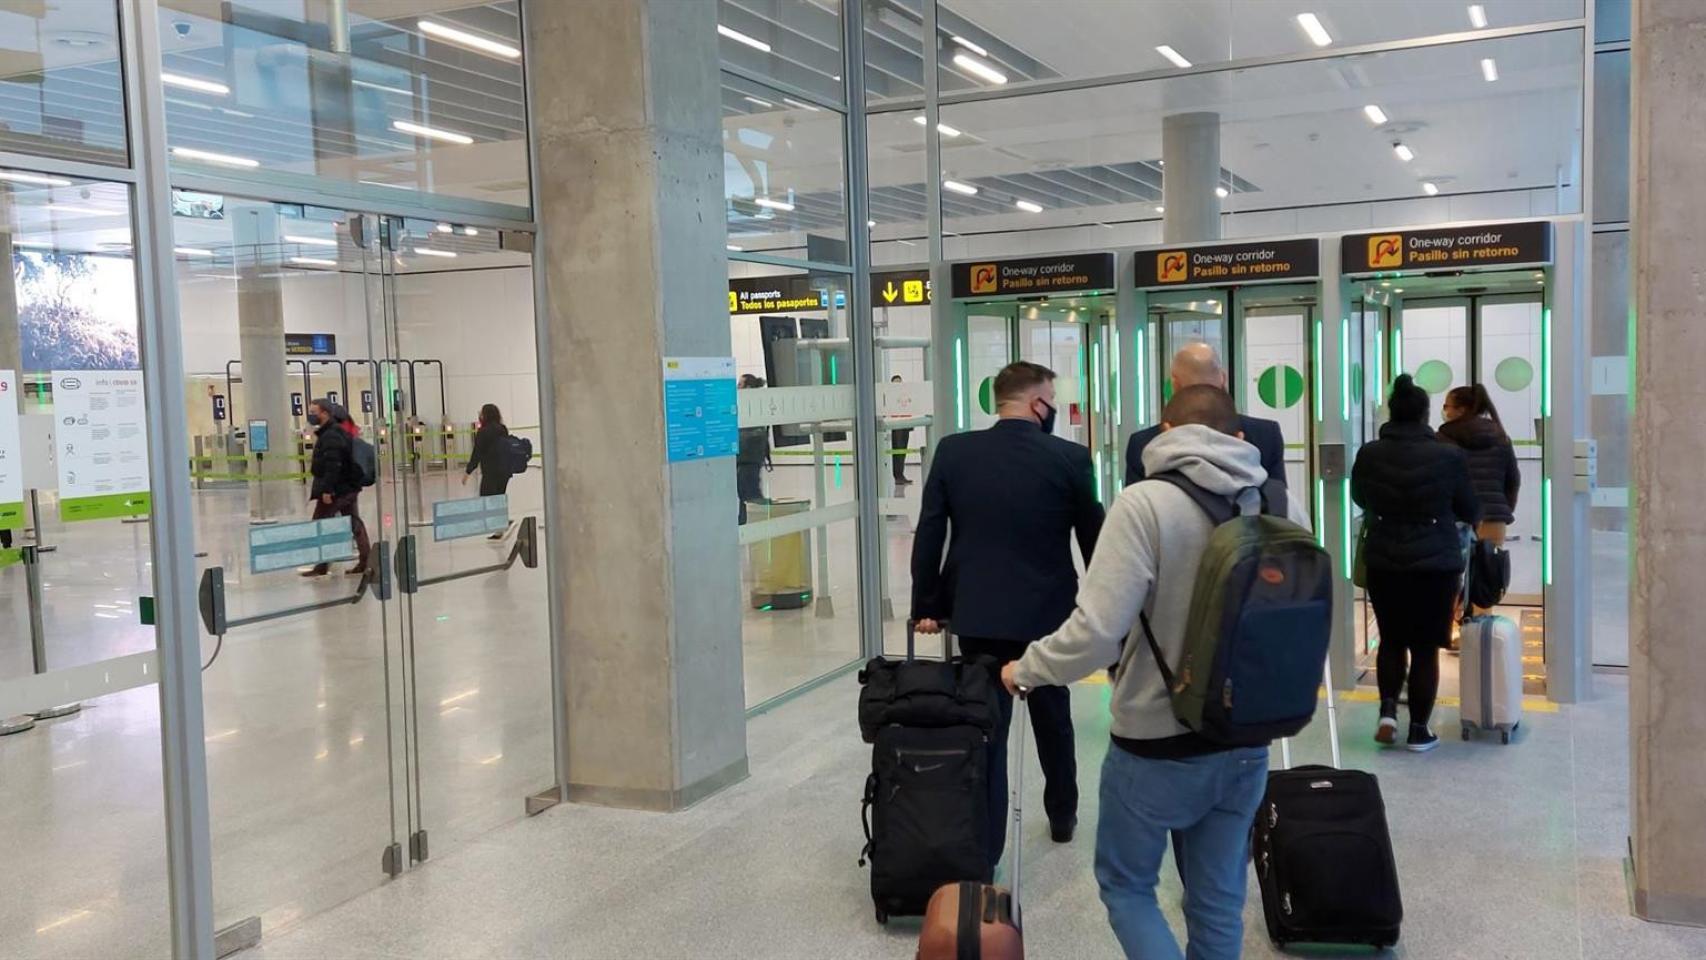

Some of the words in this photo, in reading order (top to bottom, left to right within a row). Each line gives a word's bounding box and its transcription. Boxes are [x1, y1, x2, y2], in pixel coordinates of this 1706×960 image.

[1409, 236, 1454, 249] One-way
[1457, 233, 1502, 245] corridor
[1193, 252, 1233, 265] One-way
[1236, 250, 1275, 261] corridor
[1409, 250, 1449, 262] Pasillo
[1452, 248, 1469, 259] sin
[1473, 246, 1519, 257] retorno
[1002, 266, 1038, 277] One-way
[1040, 263, 1075, 274] corridor
[1193, 266, 1228, 277] Pasillo
[1231, 264, 1247, 275] sin
[1250, 262, 1290, 273] retorno
[1003, 278, 1033, 288] Pasillo
[1036, 276, 1050, 286] sin
[1052, 275, 1088, 286] retorno
[750, 290, 781, 300] passports
[740, 301, 762, 310] Todos
[764, 300, 775, 308] los
[776, 298, 818, 309] pasaportes
